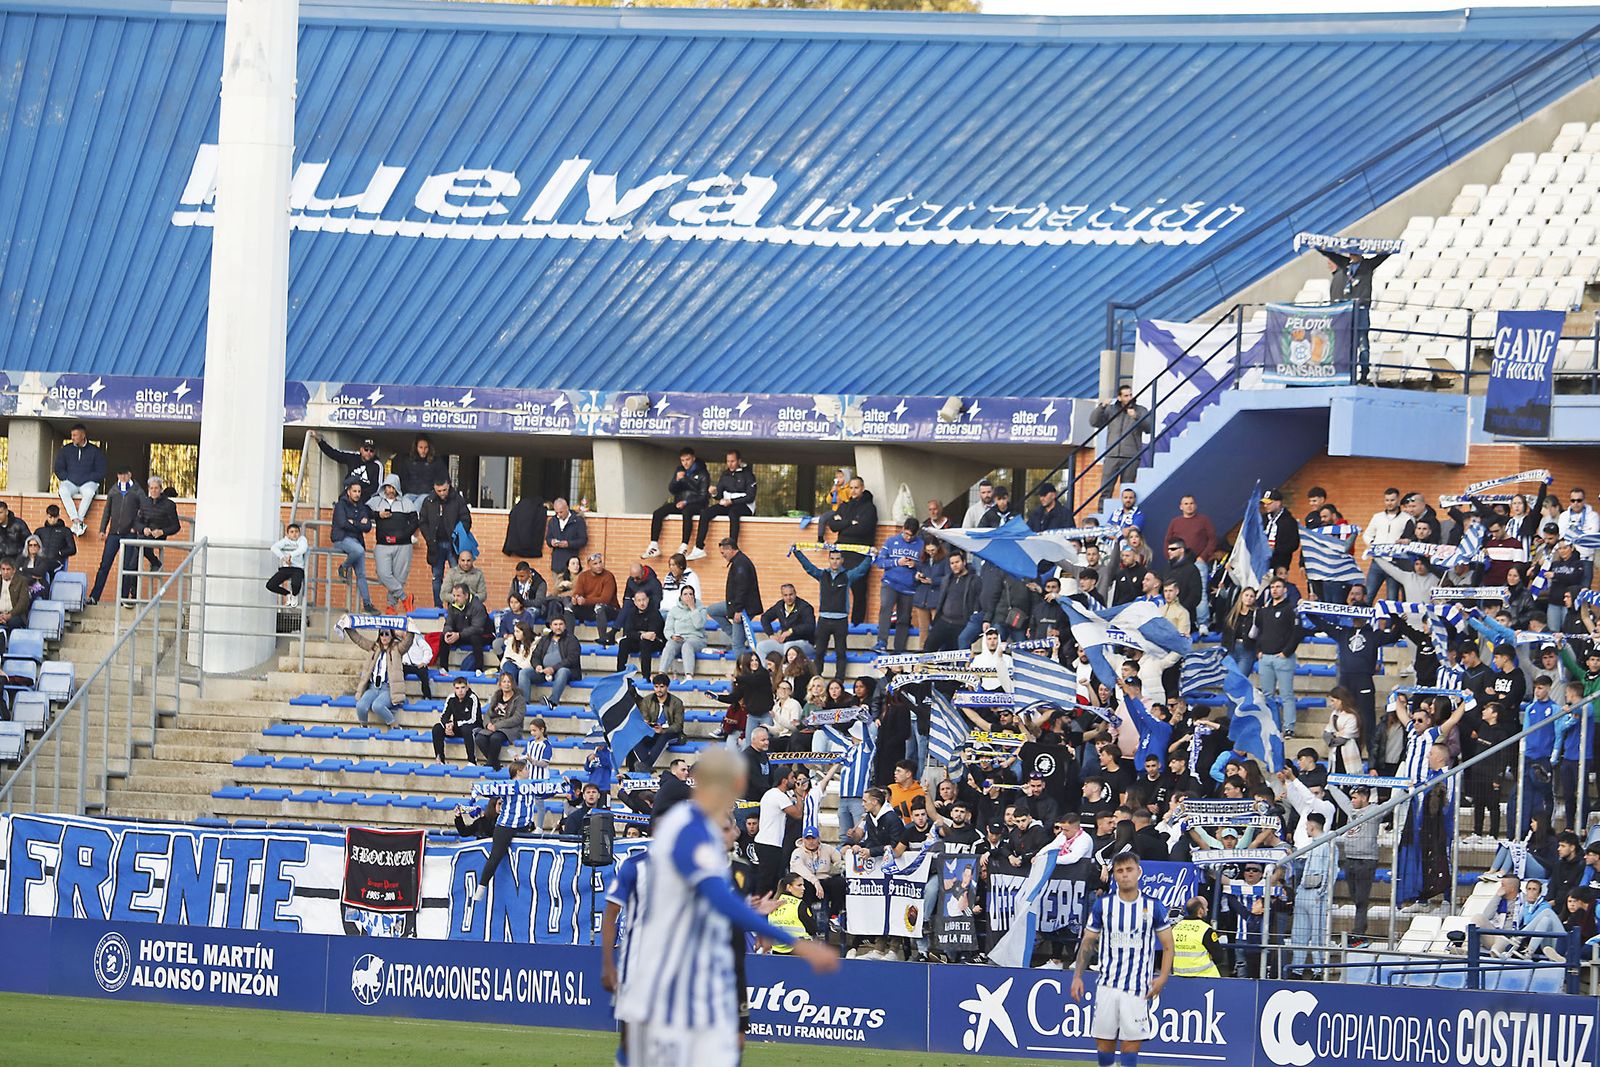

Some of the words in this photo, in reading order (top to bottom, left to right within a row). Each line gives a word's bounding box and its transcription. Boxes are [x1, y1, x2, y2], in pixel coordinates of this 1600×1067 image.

[1494, 326, 1556, 363] GANG
[1491, 358, 1506, 378] OF
[1506, 361, 1546, 382] HUELVA
[50, 385, 83, 399] alter
[135, 389, 168, 402] alter
[134, 402, 194, 415] enersun
[702, 405, 732, 419] alter
[777, 407, 808, 420] alter
[863, 409, 890, 422] alter
[421, 410, 478, 425] enersun
[513, 412, 570, 428] enersun
[1012, 409, 1039, 424] alter
[619, 418, 672, 431] enersun
[701, 418, 754, 431] enersun
[776, 420, 830, 433] enersun
[863, 422, 910, 435] enersun
[935, 422, 982, 435] enersun
[1011, 423, 1058, 436] enersun
[1319, 603, 1376, 616] RECREATIV
[353, 615, 405, 629] RECREATIVO
[473, 783, 515, 796] RENTE
[519, 782, 564, 795] ONUBA
[1231, 848, 1273, 858] HUELVA
[4, 814, 311, 933] FRENTE
[848, 878, 885, 897] Banda
[139, 939, 198, 965] HOTEL
[203, 942, 274, 970] MARTÍN
[131, 965, 205, 992] ALONSO
[209, 969, 279, 997] PINZÓN
[385, 963, 490, 1001] ATRACCIONES
[493, 968, 513, 1002] LA
[517, 968, 560, 1004] CINTA
[565, 971, 591, 1006] S.L.
[746, 980, 810, 1013] uto
[797, 1003, 886, 1029] PARTS
[1026, 978, 1227, 1045] CaiBank
[744, 1022, 773, 1036] CREA
[776, 1024, 792, 1037] TU
[794, 1025, 866, 1042] FRANQUICIA
[1316, 1011, 1451, 1064] COPIADORAS
[1456, 1008, 1594, 1067] COSTALUZ
